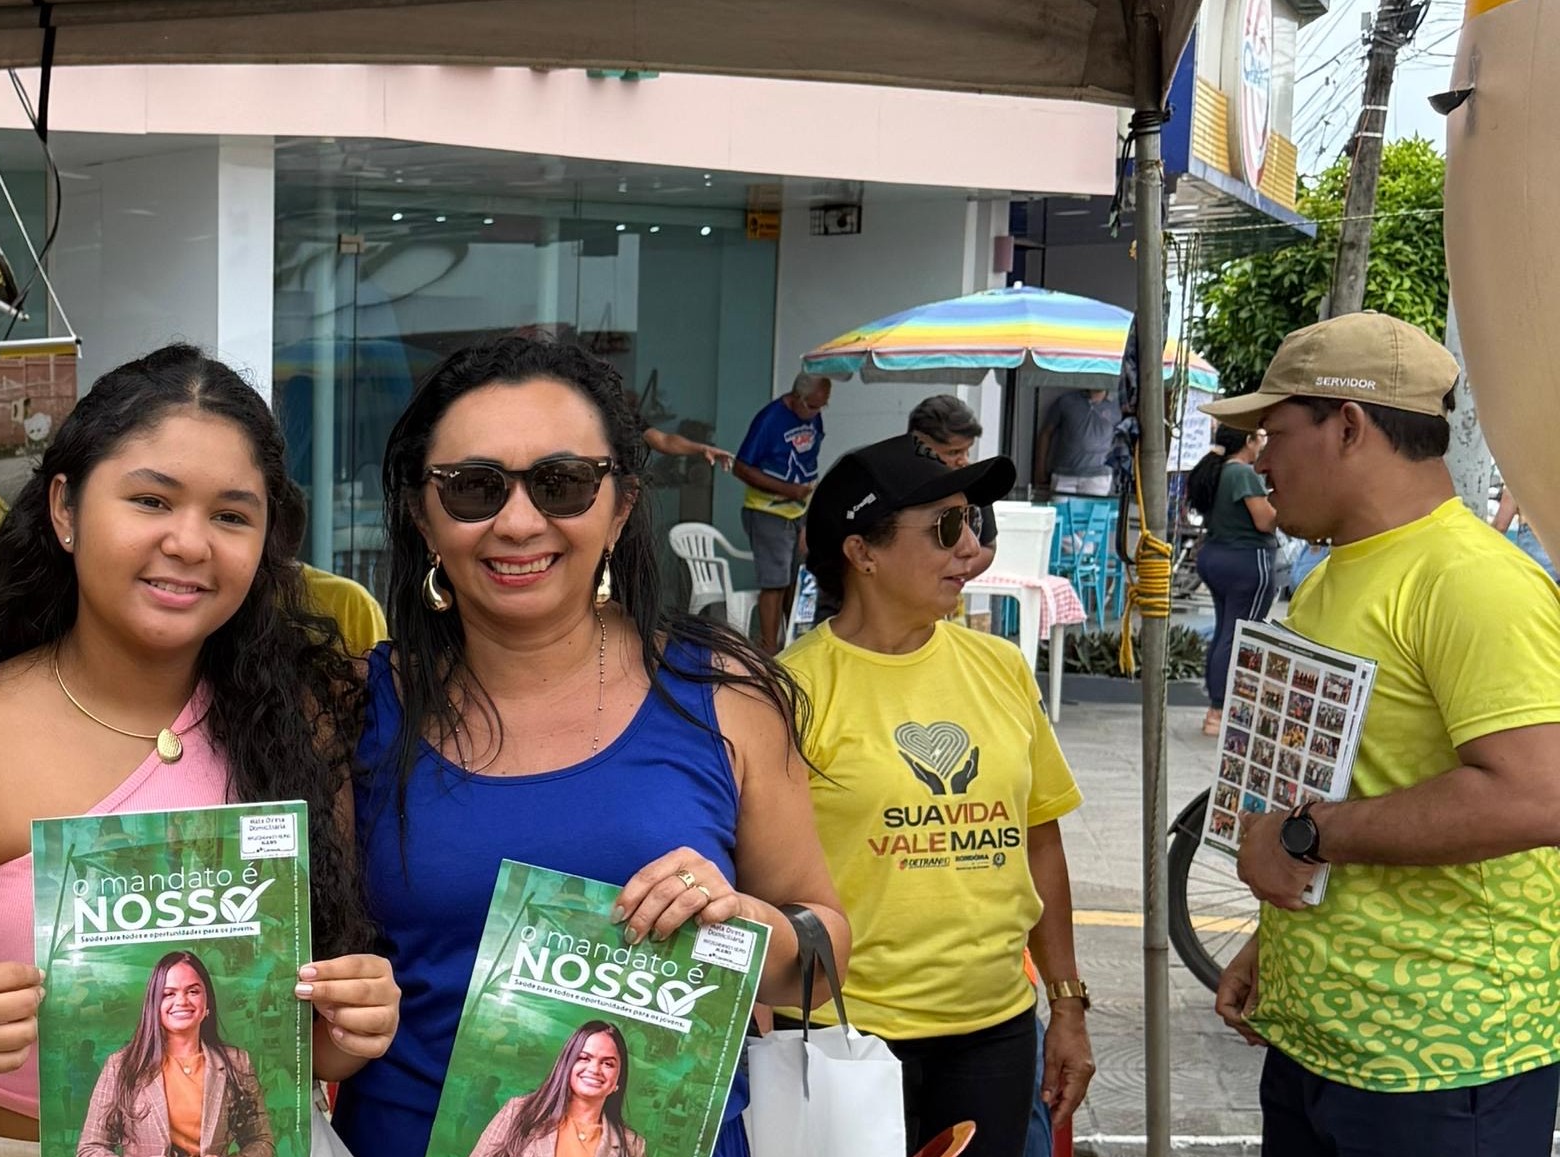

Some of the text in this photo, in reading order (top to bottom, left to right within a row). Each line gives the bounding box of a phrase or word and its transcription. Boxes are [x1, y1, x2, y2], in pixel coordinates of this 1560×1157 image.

[1314, 376, 1377, 390] SERVIDOR
[883, 800, 1010, 829] SUA VIDA
[867, 827, 1021, 856] VALE MAIS
[72, 861, 258, 896] o mandato é
[73, 882, 262, 934] NOSSO
[520, 925, 537, 942] o
[546, 930, 678, 977] mandato
[687, 963, 705, 984] é
[511, 941, 702, 1017] NOSSO
